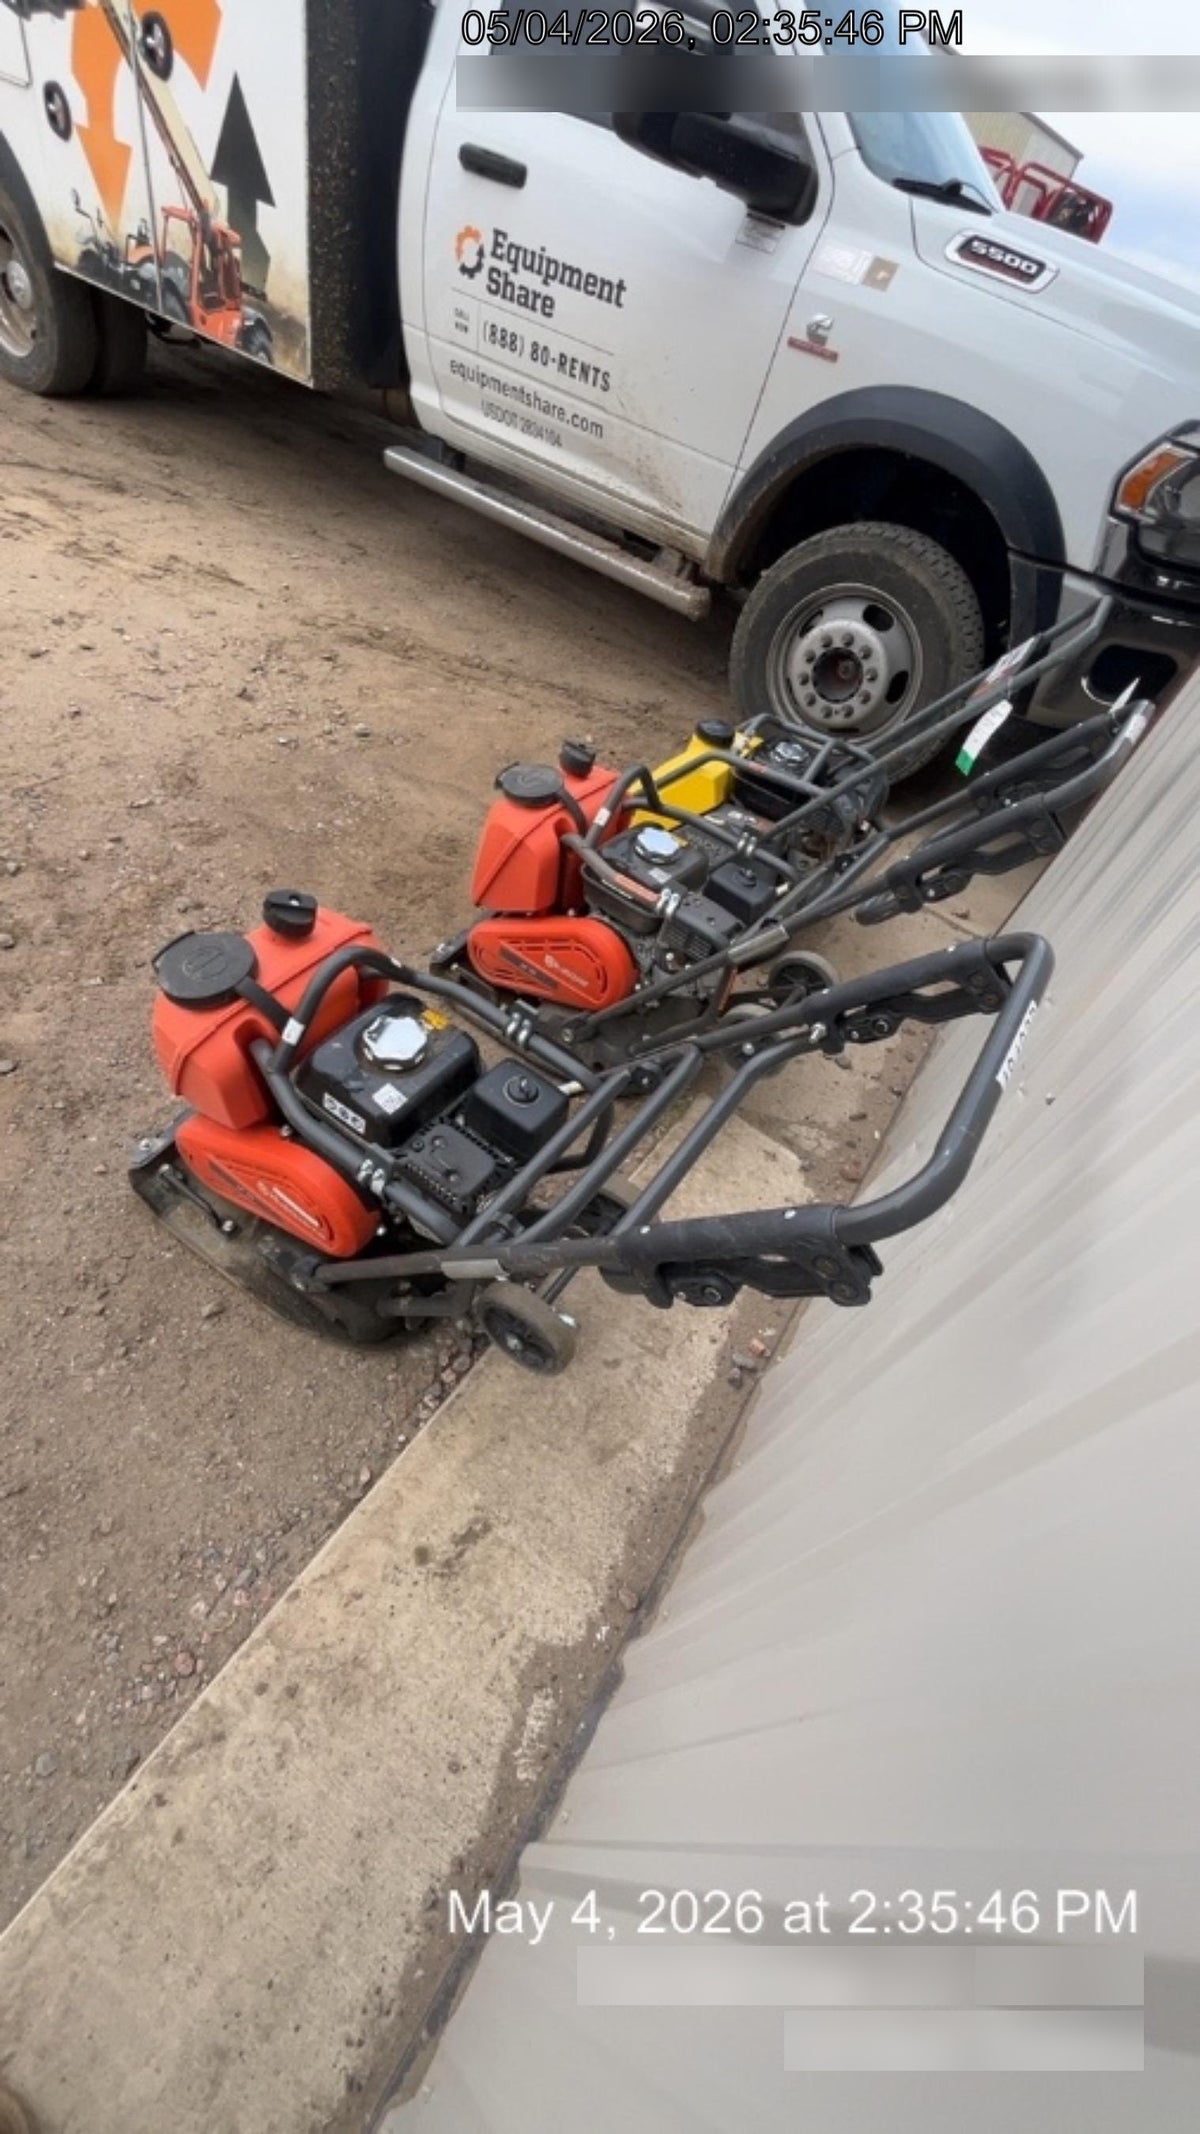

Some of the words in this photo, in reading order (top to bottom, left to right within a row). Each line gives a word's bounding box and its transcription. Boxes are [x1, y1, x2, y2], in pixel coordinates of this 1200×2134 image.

[486, 266, 556, 319] Share
[490, 227, 627, 309] Equipment
[971, 240, 1038, 275] 5500
[483, 320, 525, 358] (888)
[530, 340, 611, 393] 80-RENTS
[450, 359, 604, 440] equipmentshare.com
